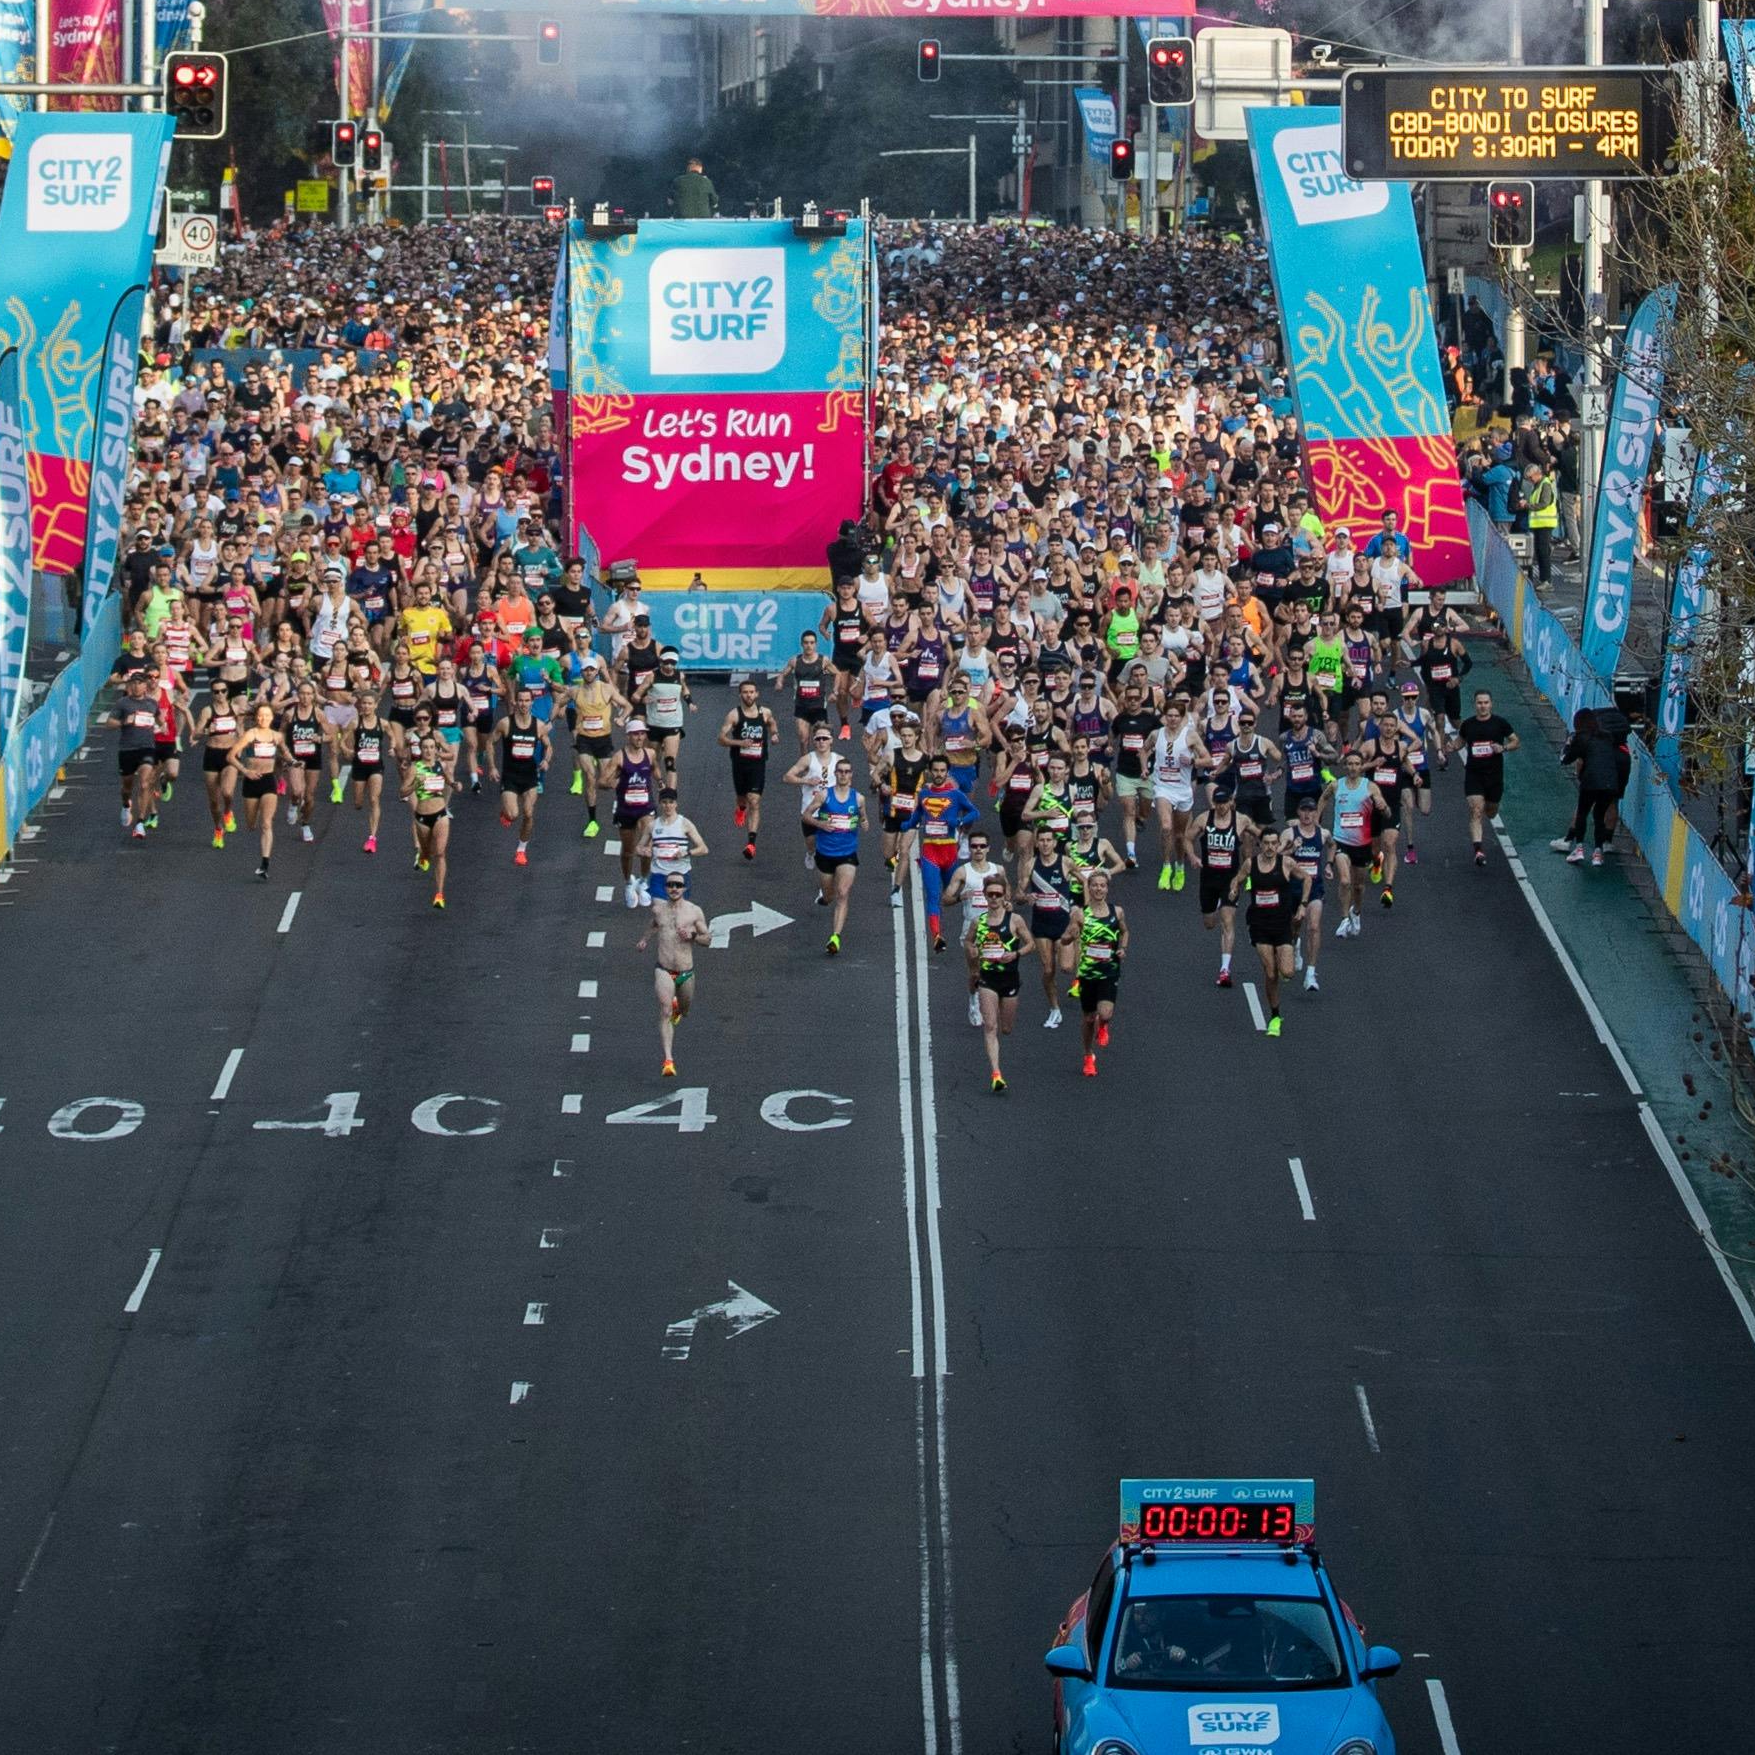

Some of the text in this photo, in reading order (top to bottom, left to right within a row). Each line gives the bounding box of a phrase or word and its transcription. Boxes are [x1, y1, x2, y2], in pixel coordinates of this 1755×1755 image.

[58, 15, 80, 28] Let's
[1430, 86, 1598, 111] CITY TO SURF
[1389, 111, 1639, 134] CBD-BONDI CLOSURES
[1390, 135, 1460, 158] TODAY
[1472, 135, 1556, 158] 3:30AM
[1596, 135, 1640, 158] 4PM
[38, 156, 123, 182] CITY2
[1287, 149, 1342, 175] CITY
[42, 184, 117, 206] SURF
[170, 189, 195, 201] ollege
[186, 225, 211, 242] 40
[181, 253, 213, 264] AREA
[663, 275, 774, 311] CITY2
[669, 313, 768, 342] SURF
[643, 409, 792, 438] Let's Run
[621, 443, 815, 490] Sydney!
[674, 599, 779, 632] CITY2
[679, 632, 773, 661] SURF
[299, 726, 314, 735] run
[741, 730, 764, 738] crew
[748, 724, 764, 732] run
[365, 735, 381, 744] run
[1207, 832, 1235, 847] DELTA
[1253, 1489, 1294, 1499] GWM
[1145, 1506, 1292, 1537] 00:00:13
[1196, 1710, 1271, 1722] CITY2
[1202, 1722, 1268, 1732] SURF
